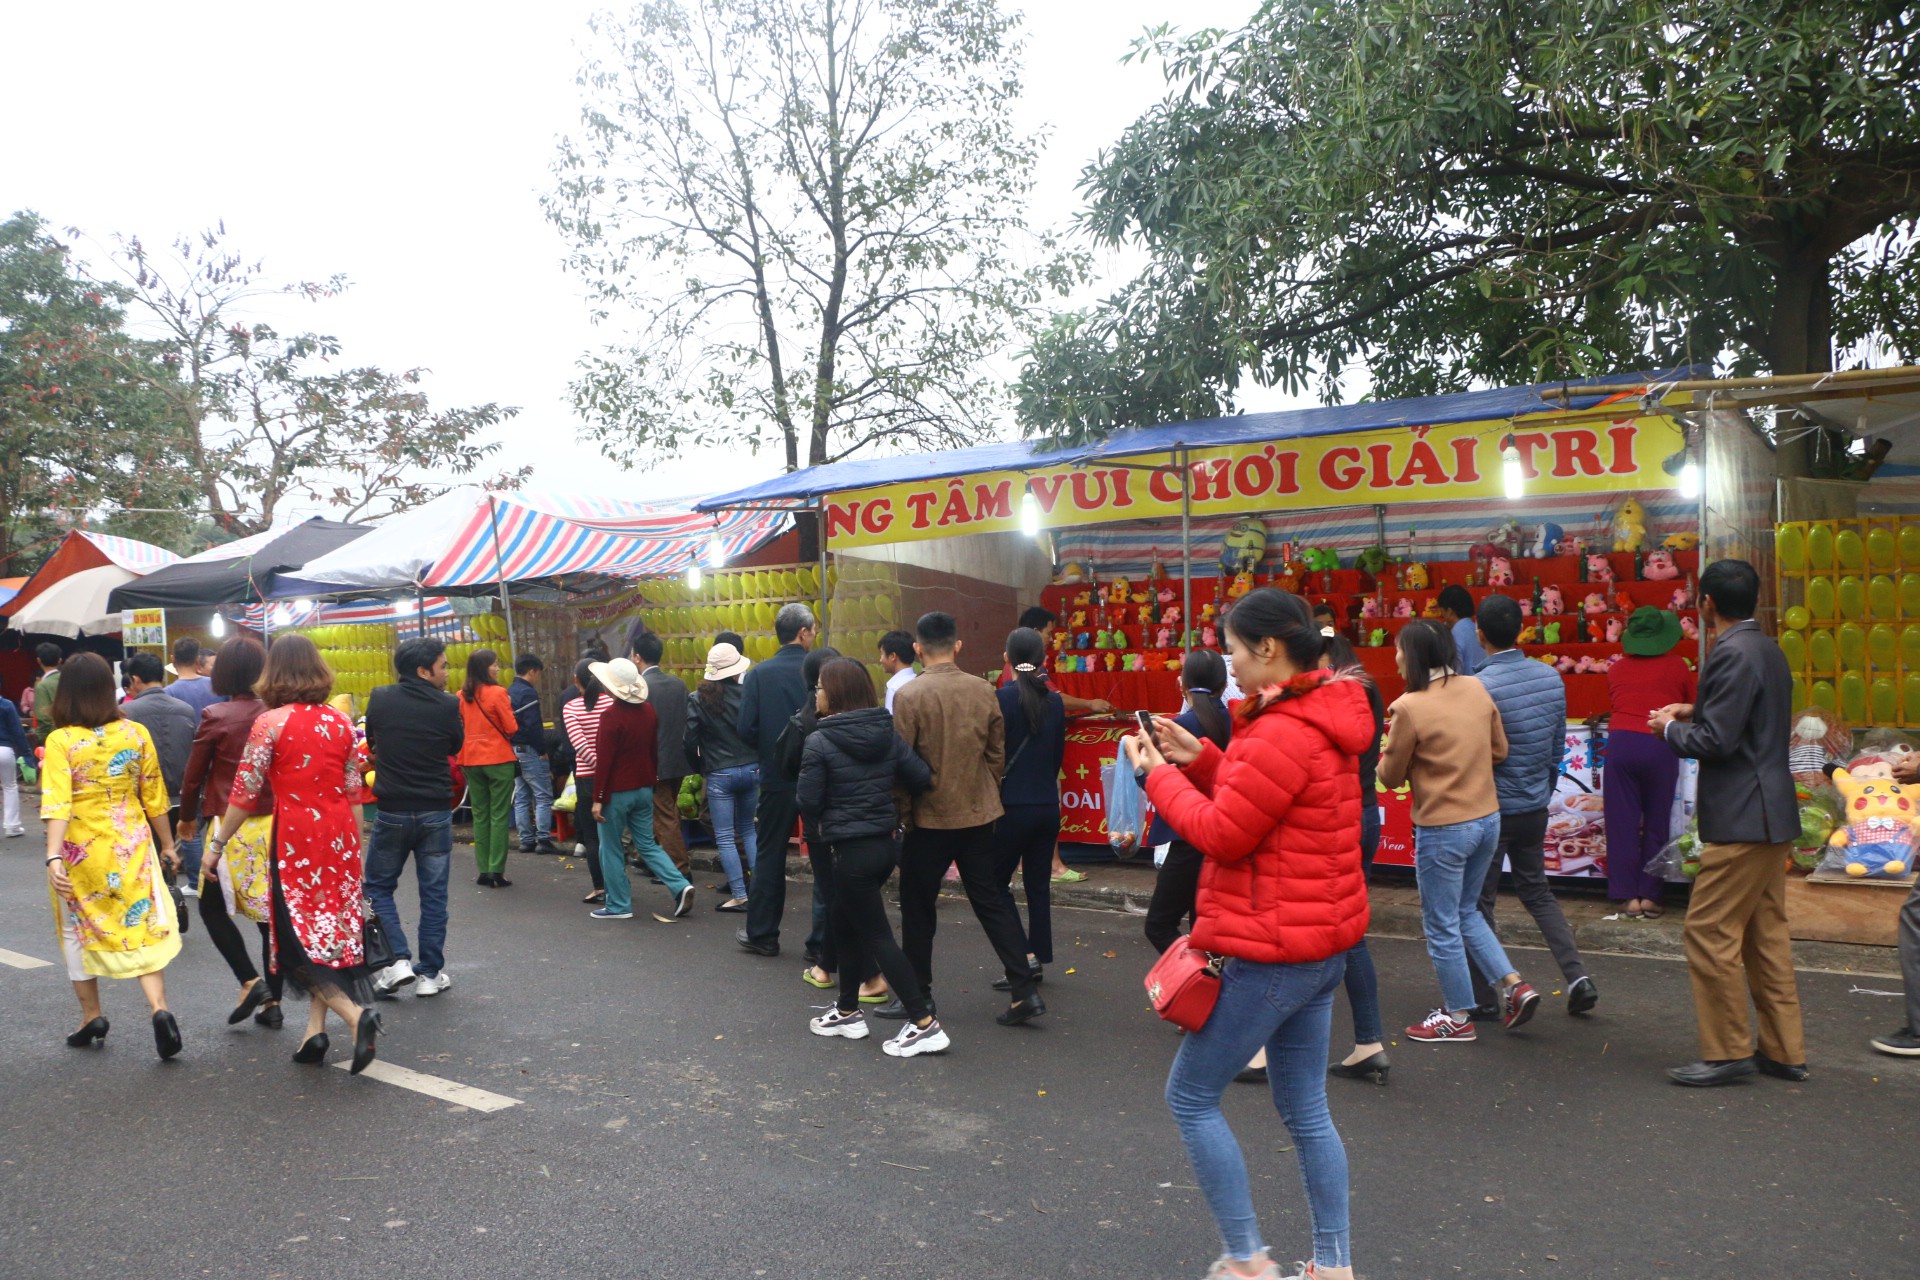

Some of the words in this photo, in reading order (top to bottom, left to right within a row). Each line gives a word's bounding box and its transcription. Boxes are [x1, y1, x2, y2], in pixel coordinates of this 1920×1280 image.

[906, 477, 1014, 529] TÂM
[1028, 468, 1134, 514] VUI
[1149, 445, 1300, 502] CHƠI
[1319, 424, 1480, 491] GIẢI
[1499, 419, 1638, 479] TRÍ
